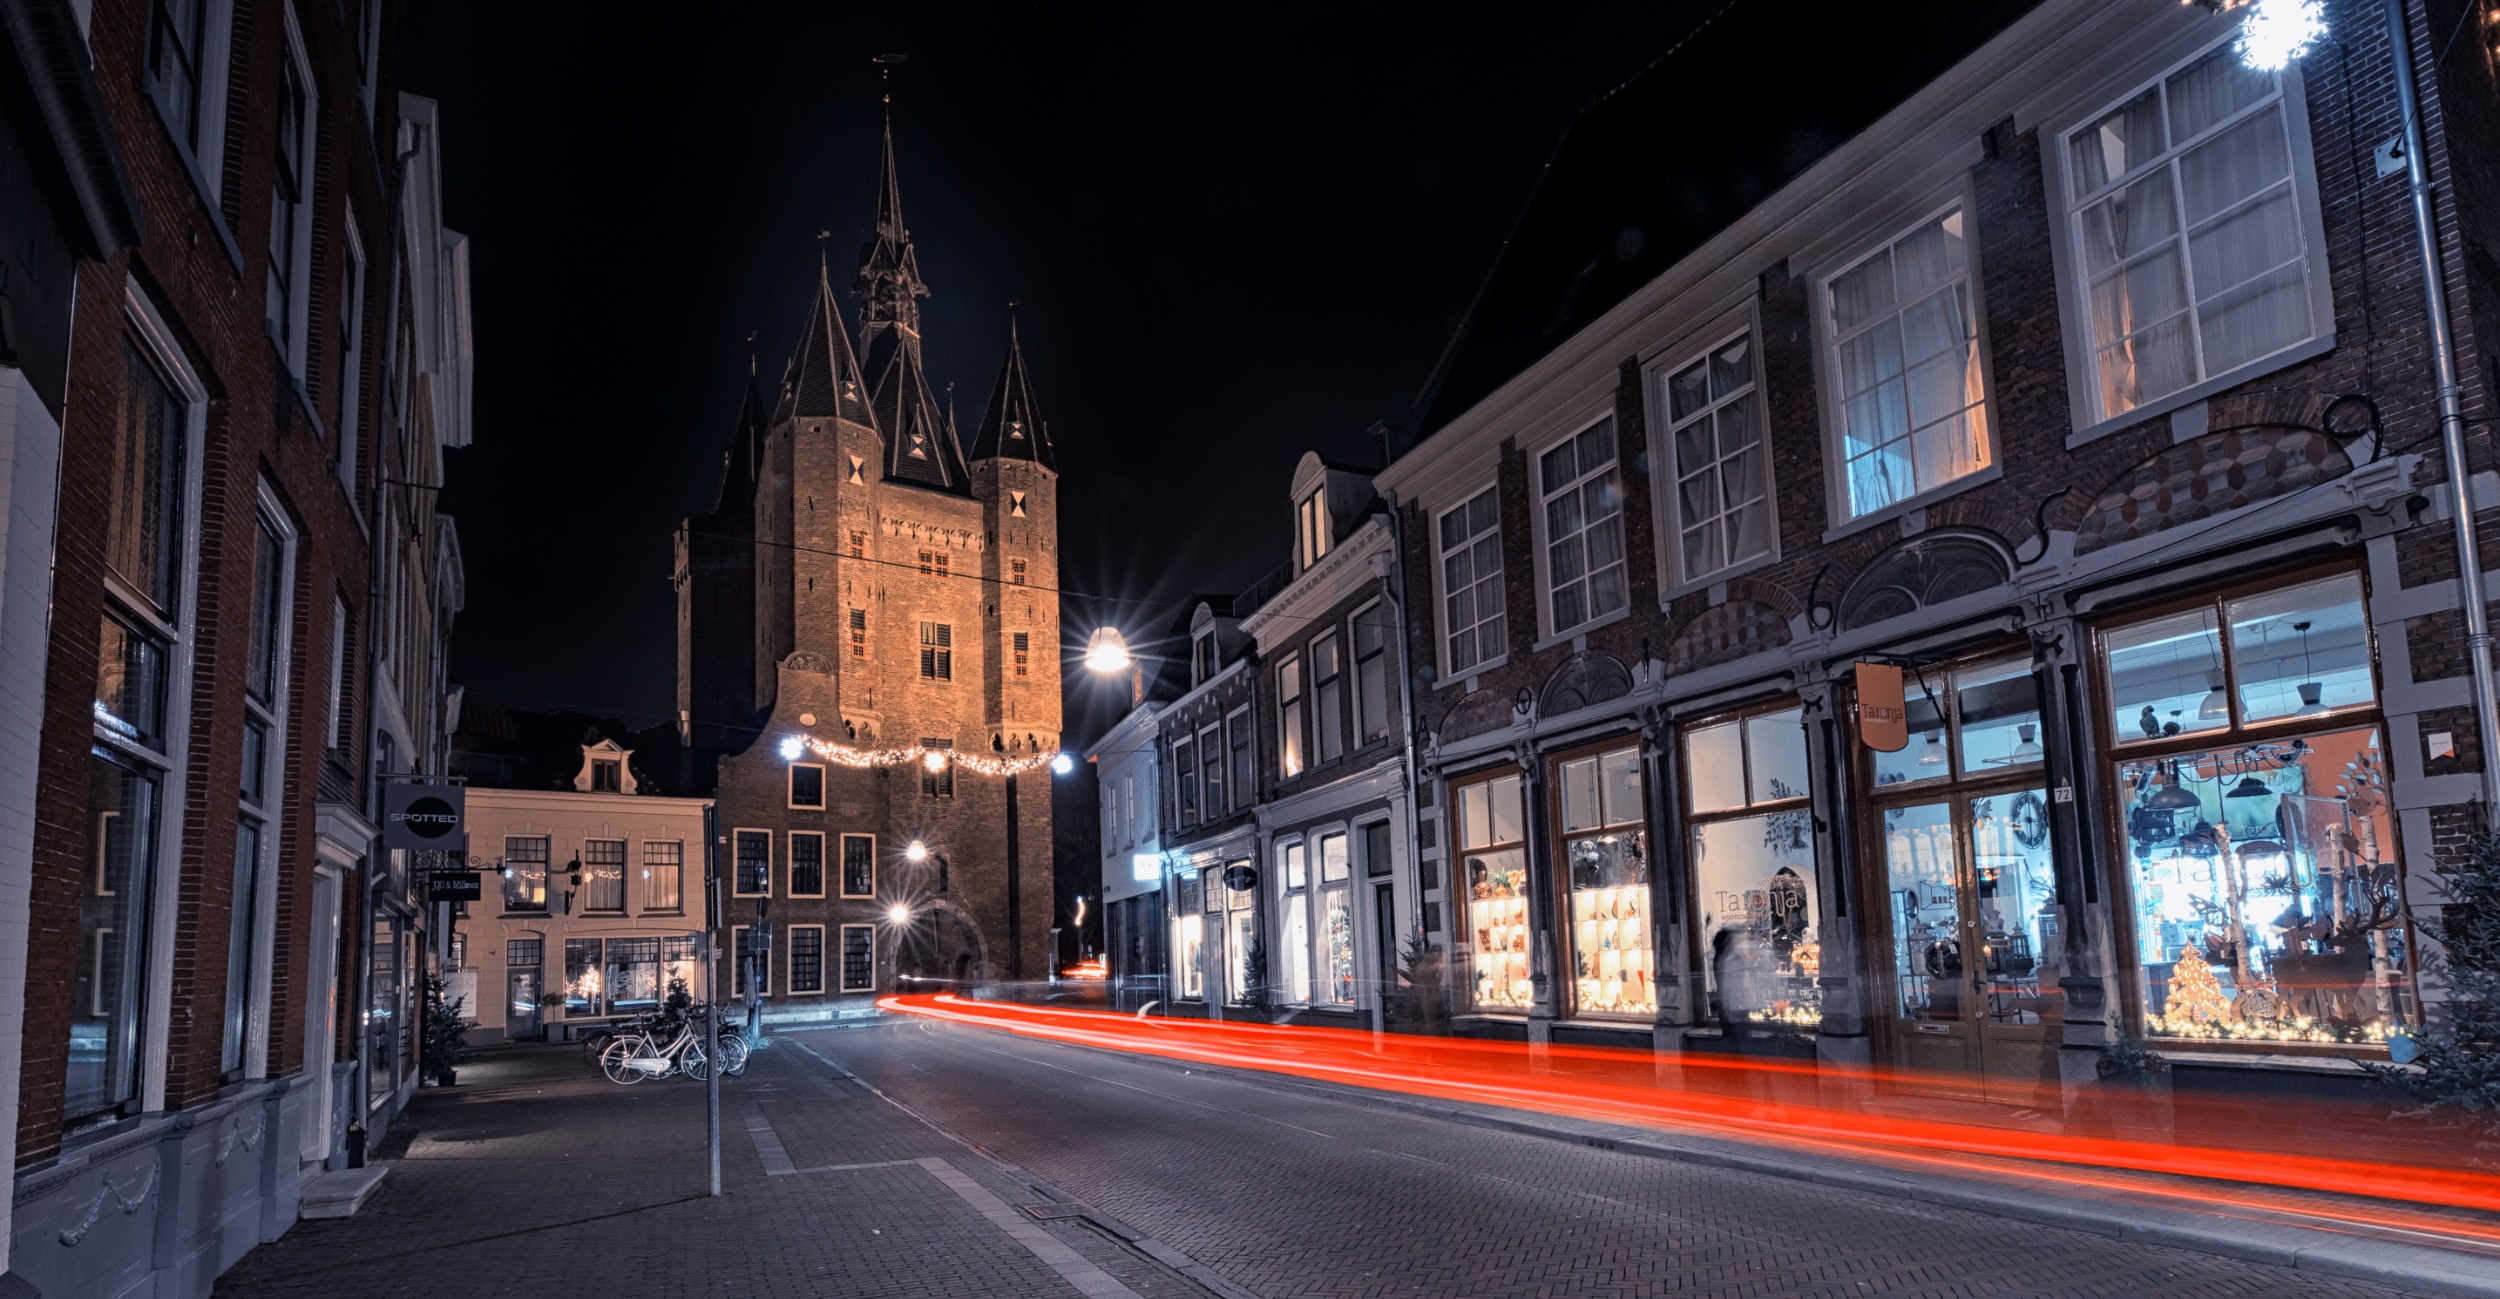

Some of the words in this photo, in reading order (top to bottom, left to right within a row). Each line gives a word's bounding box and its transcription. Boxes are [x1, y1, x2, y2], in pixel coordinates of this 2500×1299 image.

[1861, 704, 1903, 723] Taronja
[2055, 789, 2070, 801] 72
[390, 813, 459, 823] SPOTTED
[445, 880, 452, 890] &
[1715, 890, 1800, 917] Taronja
